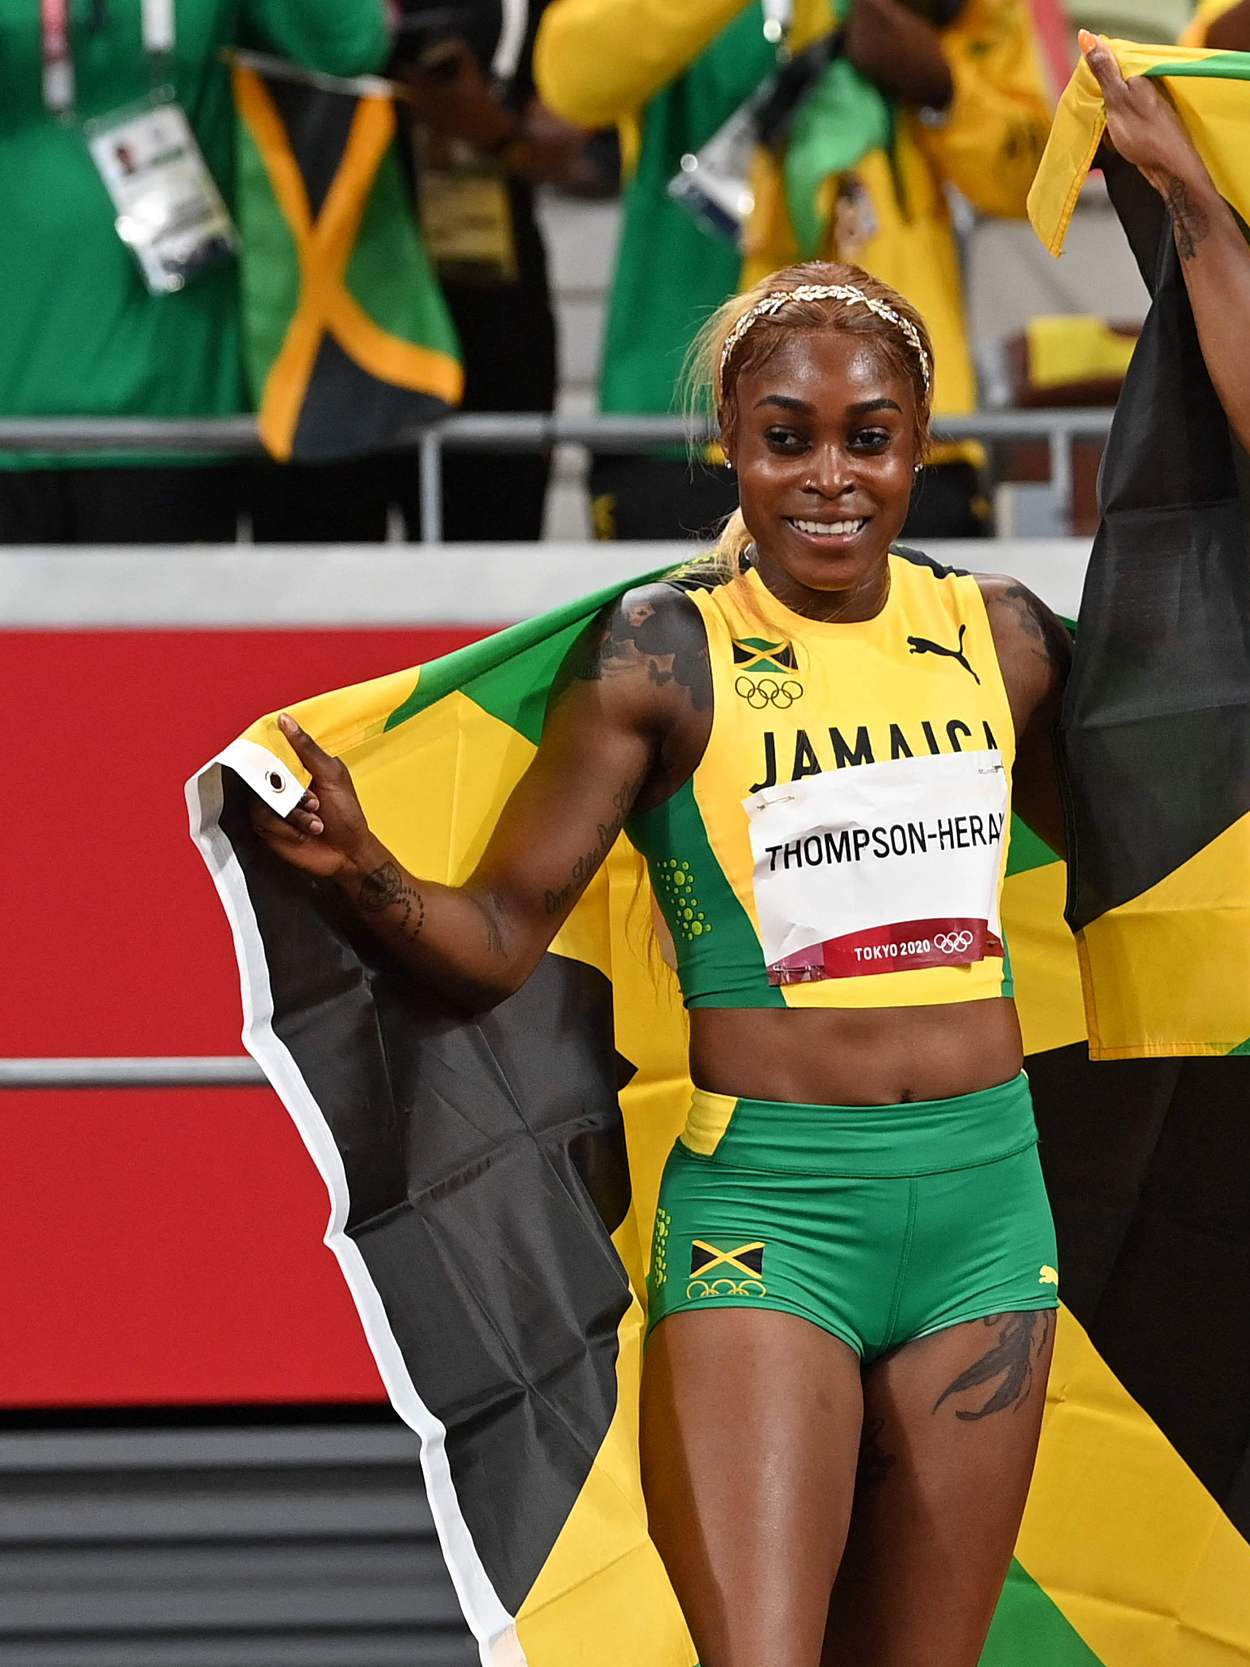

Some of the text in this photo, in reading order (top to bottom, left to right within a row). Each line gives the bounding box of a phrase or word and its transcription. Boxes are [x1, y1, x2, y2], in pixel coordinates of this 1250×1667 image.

[765, 812, 1004, 872] THOMPSON-HERA
[853, 939, 931, 962] TOKYO 2020
